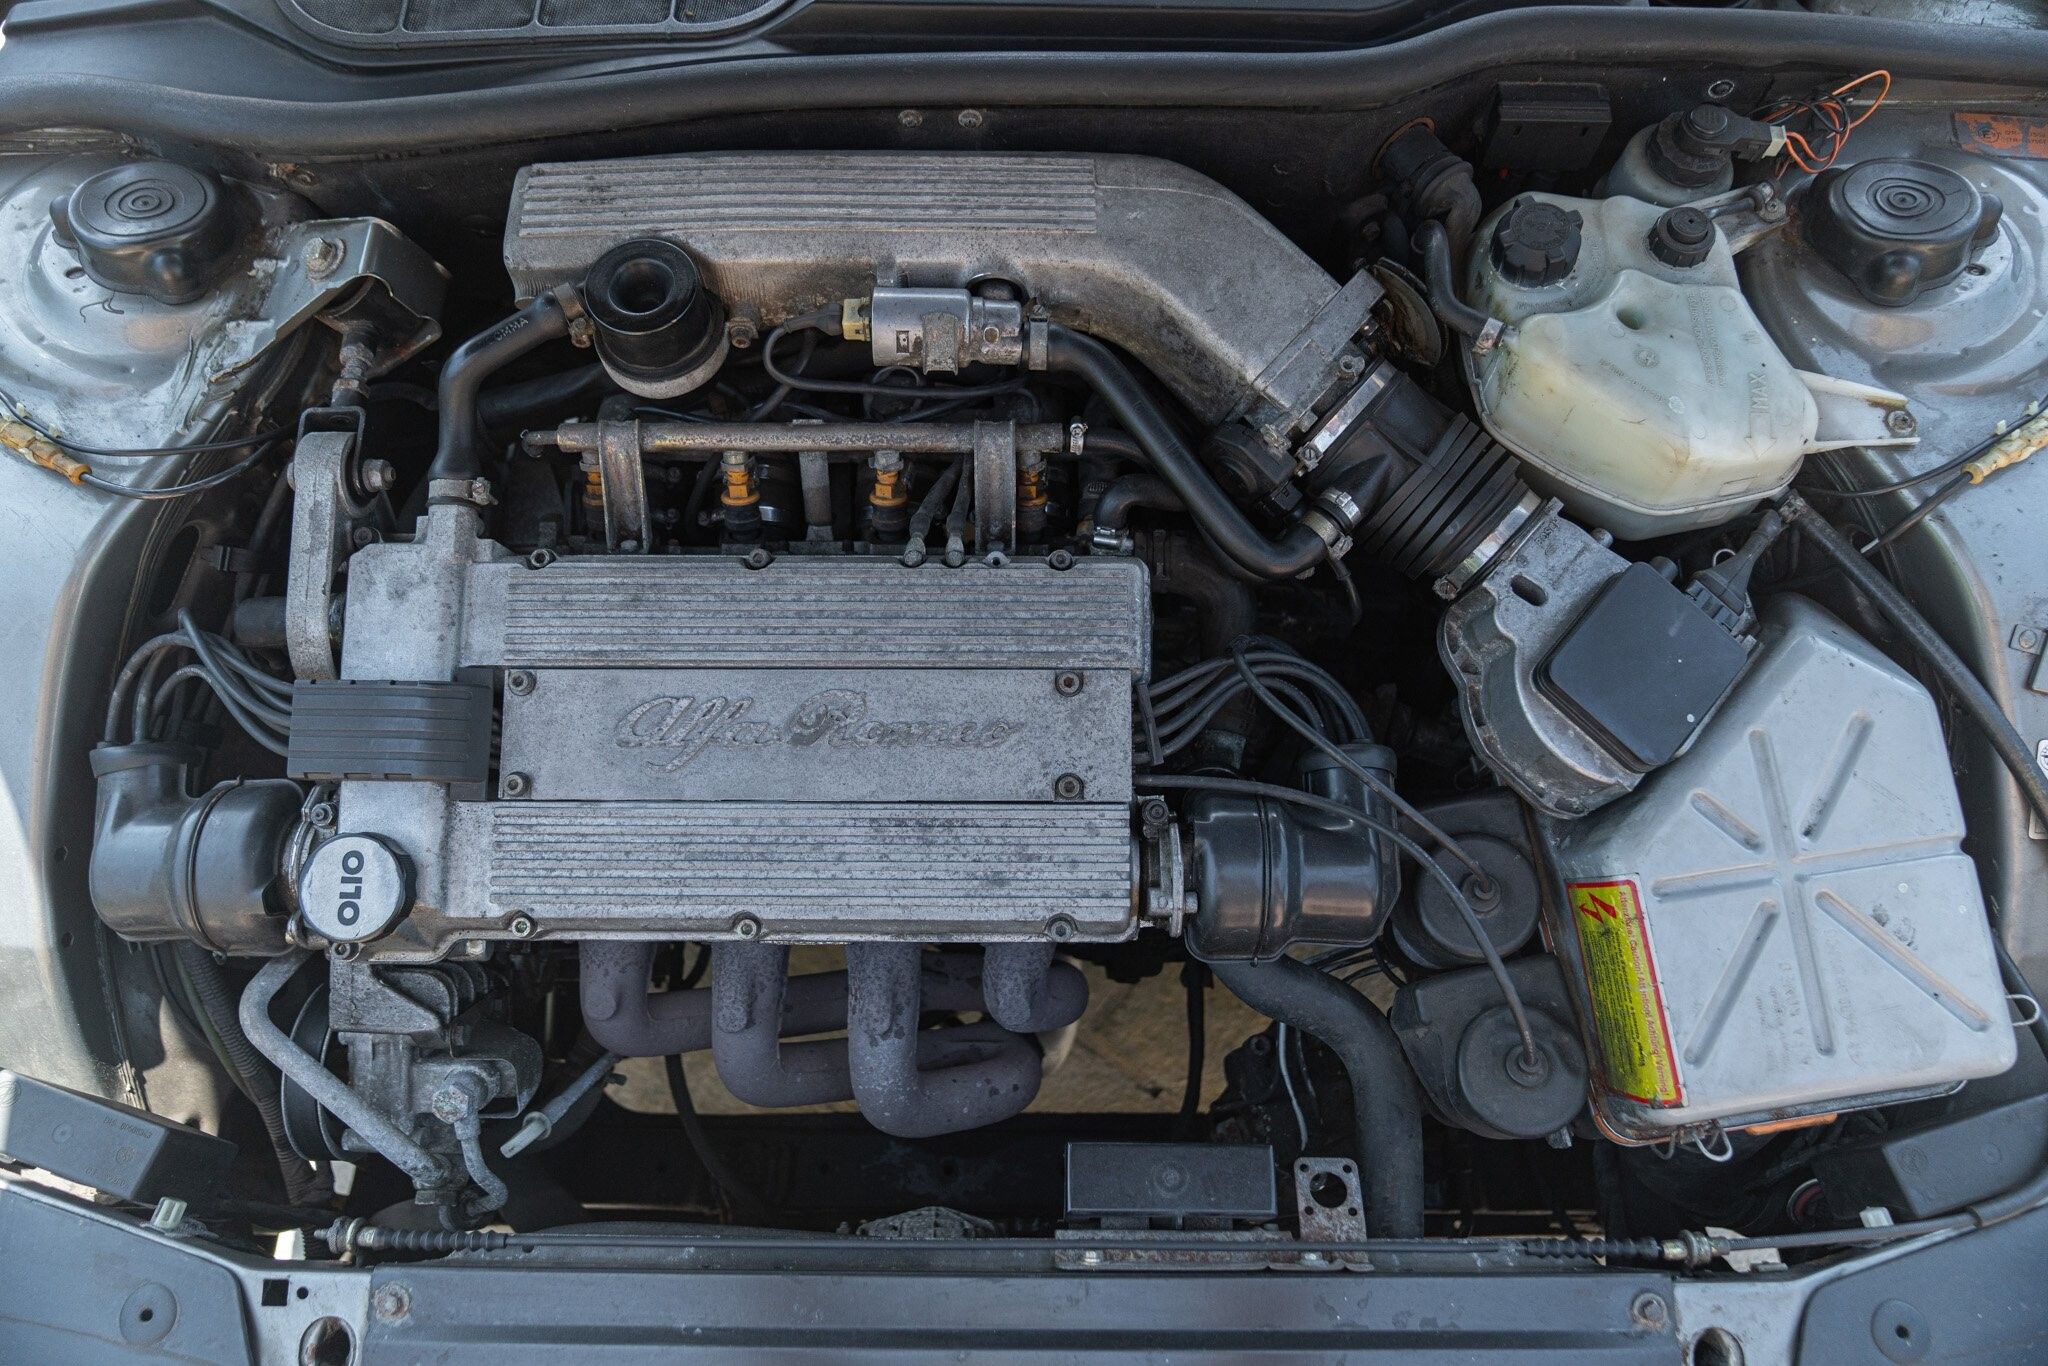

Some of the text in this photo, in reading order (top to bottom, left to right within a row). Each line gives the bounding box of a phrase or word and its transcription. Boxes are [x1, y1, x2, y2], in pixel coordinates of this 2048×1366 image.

[1749, 373, 1768, 409] MAX
[615, 688, 1028, 774] Alfa Romeo
[337, 849, 364, 926] OLIO
